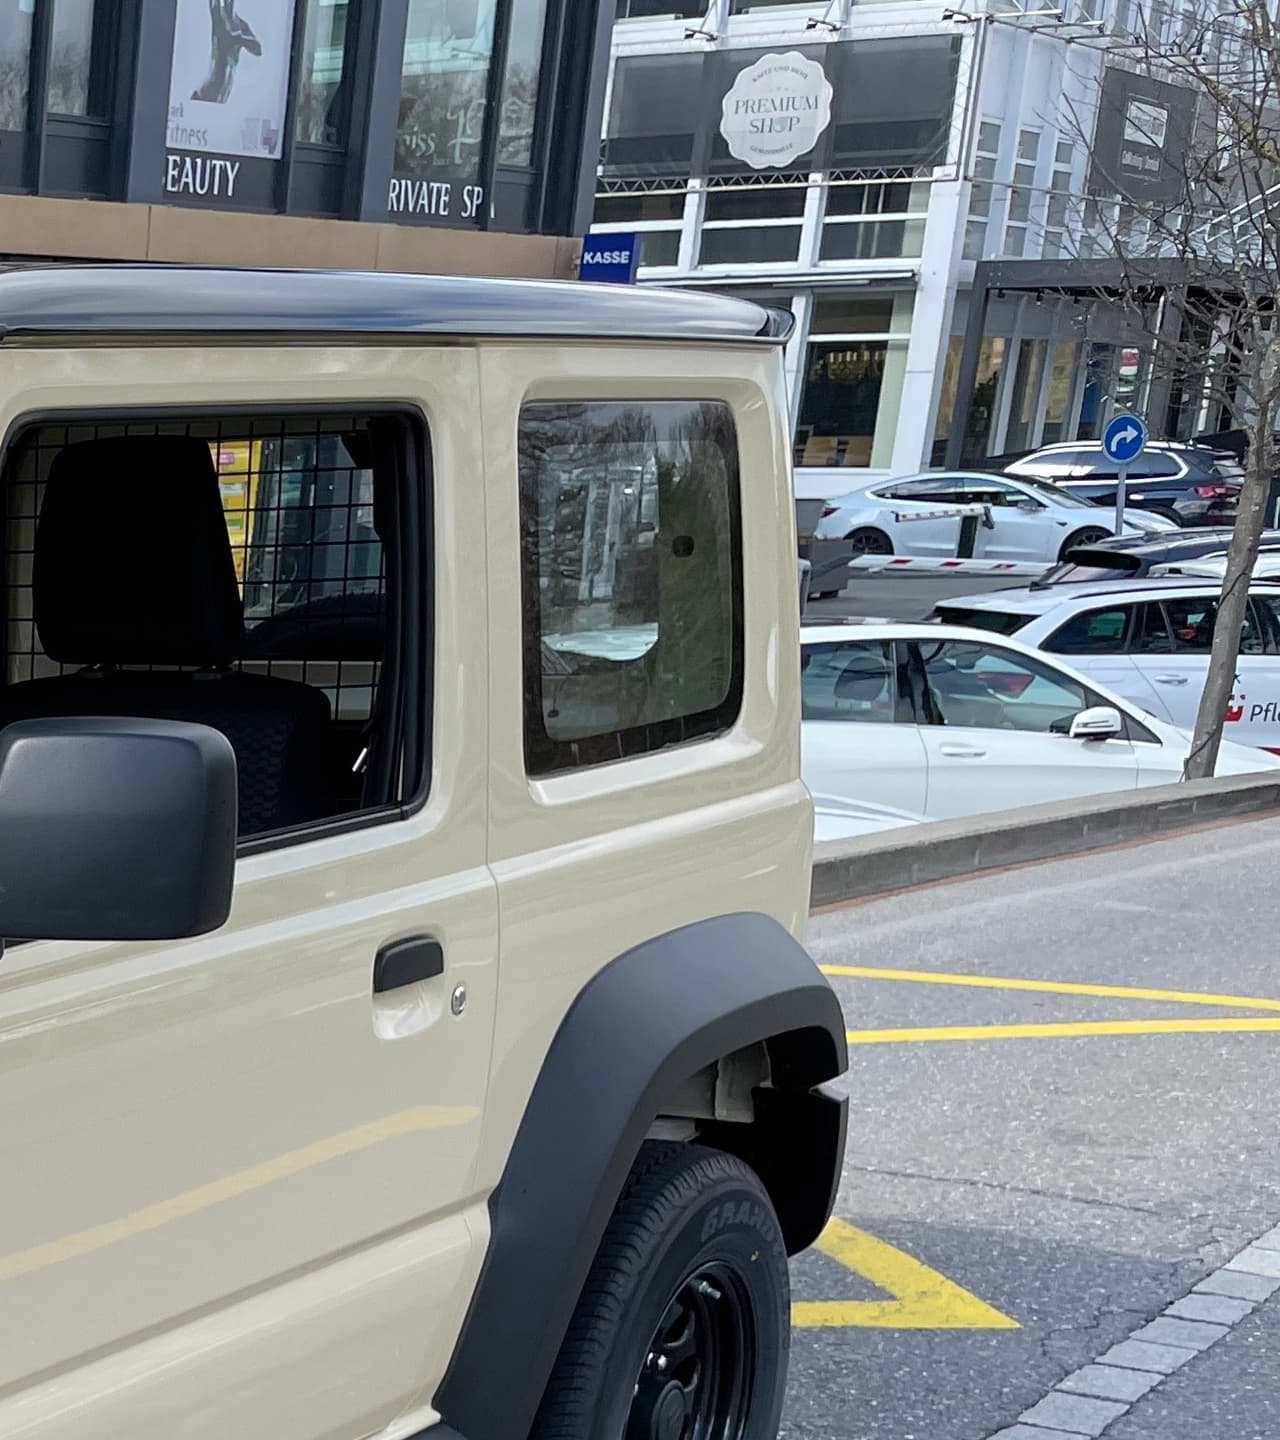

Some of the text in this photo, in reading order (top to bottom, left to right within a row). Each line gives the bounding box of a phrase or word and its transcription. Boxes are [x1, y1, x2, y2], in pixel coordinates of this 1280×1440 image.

[734, 95, 819, 115] PREMIUM
[749, 116, 801, 135] SHOP
[162, 154, 240, 197] EAUTY
[387, 178, 495, 218] RIVATE SP
[583, 251, 630, 265] KASSE
[1250, 702, 1280, 722] Pfl
